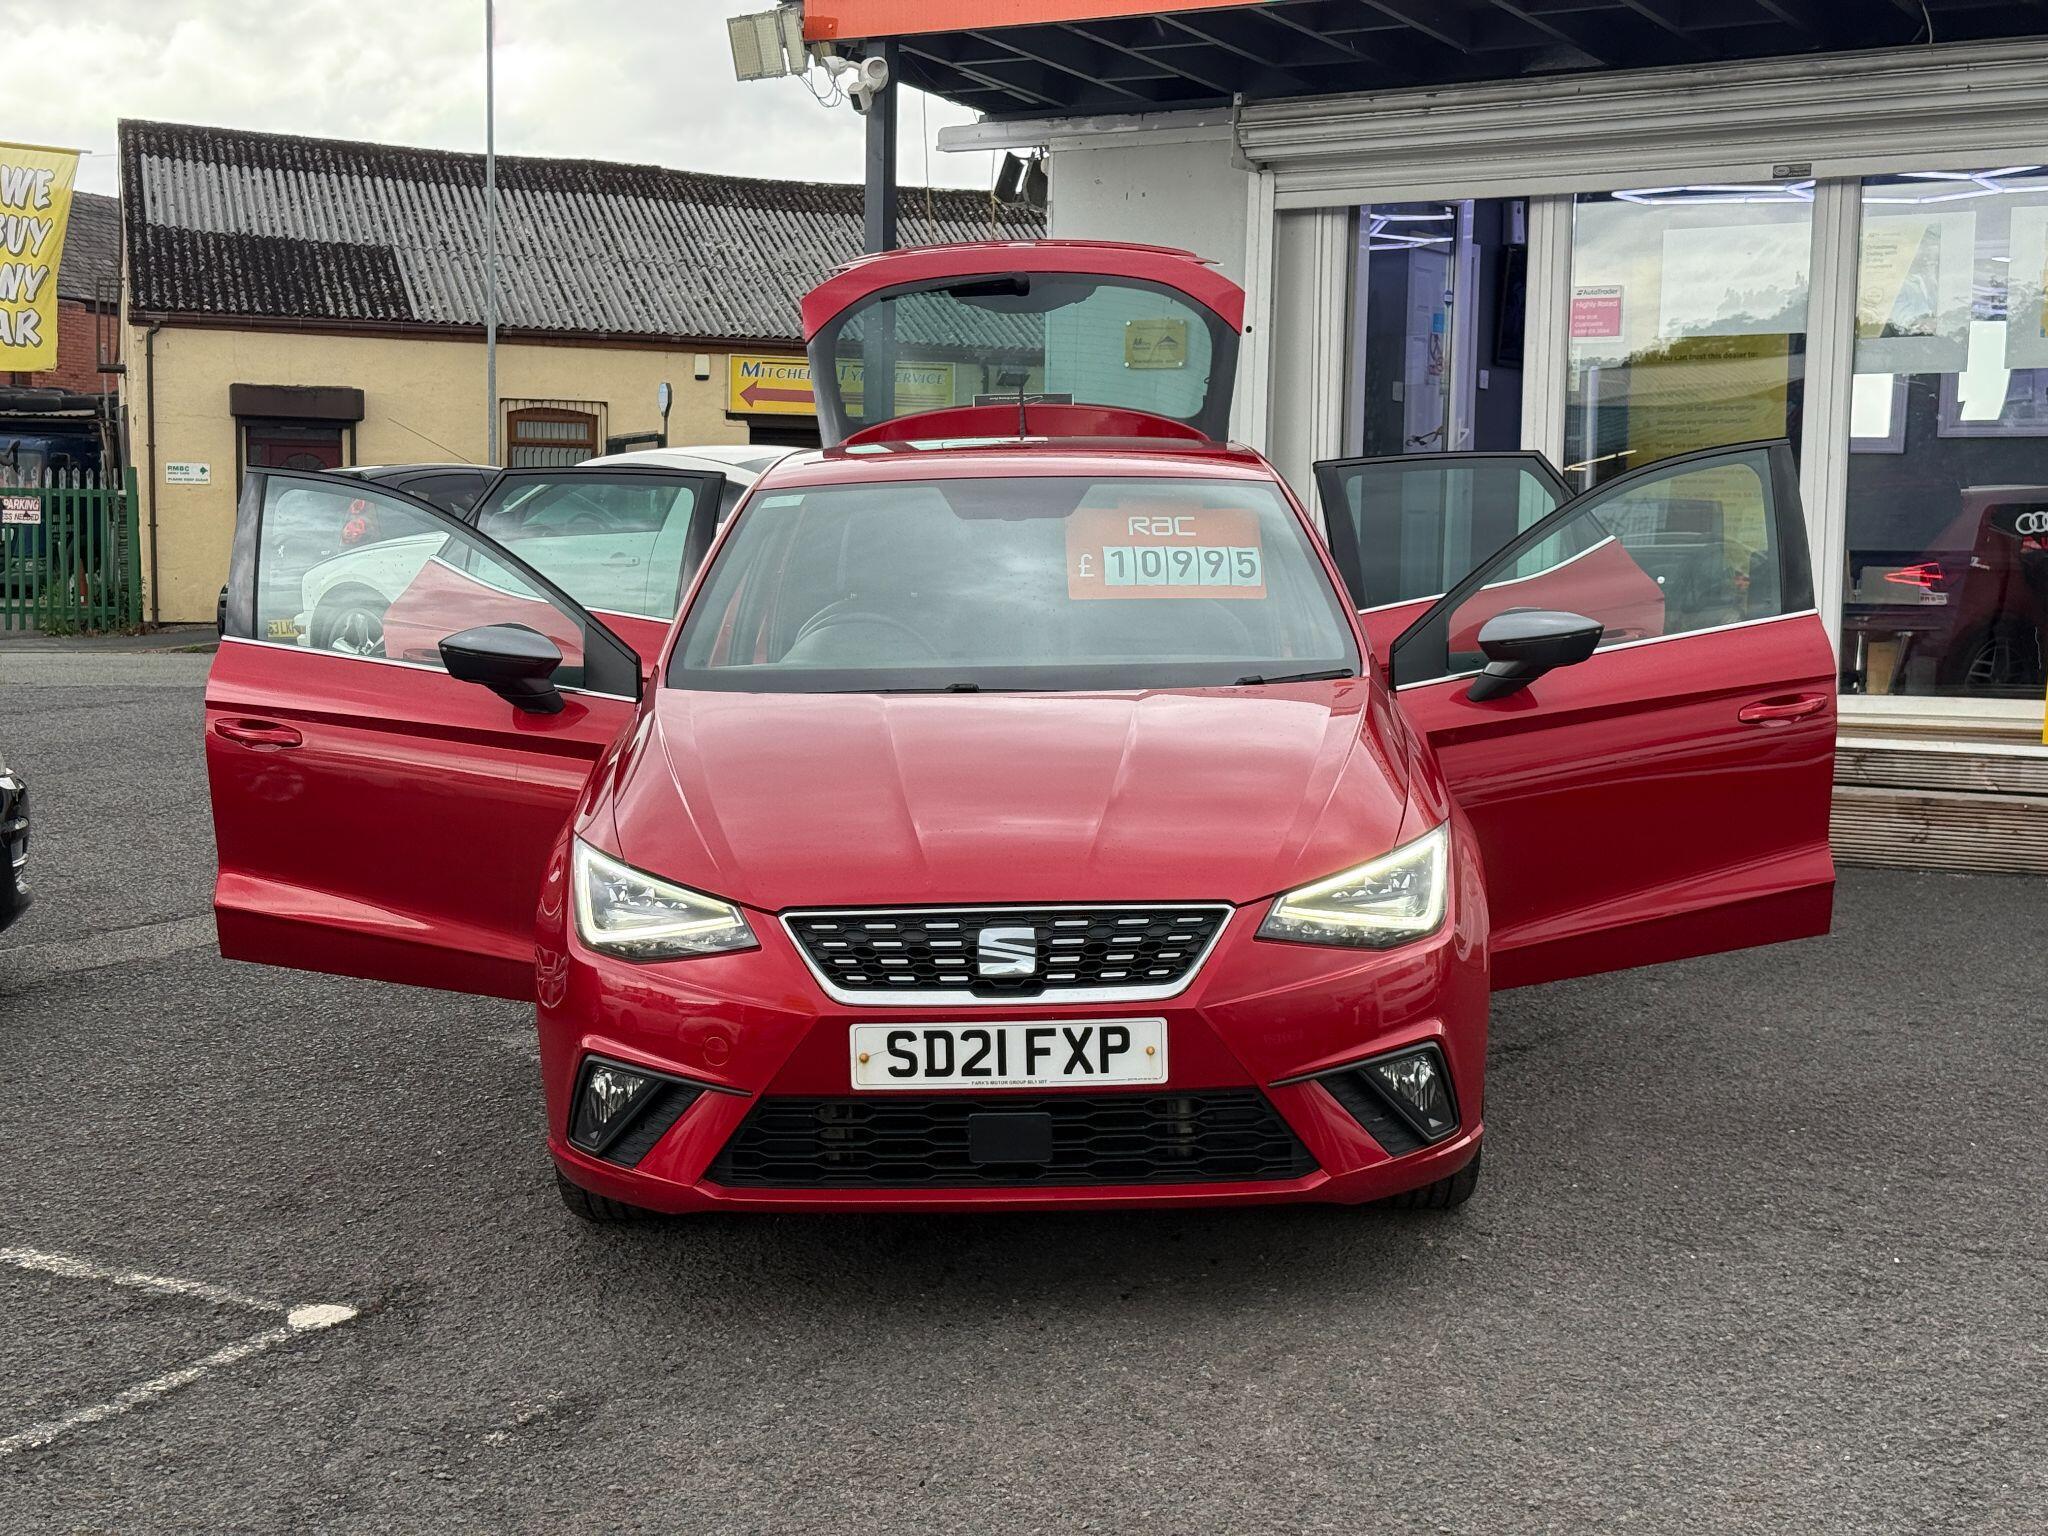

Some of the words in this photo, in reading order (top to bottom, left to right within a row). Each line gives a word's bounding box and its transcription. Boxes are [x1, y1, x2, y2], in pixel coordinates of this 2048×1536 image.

[0, 164, 54, 212] WE
[0, 262, 49, 302] NY
[0, 308, 42, 347] AR
[741, 361, 812, 380] MITCHEL
[895, 371, 944, 385] ERVICE
[2, 498, 39, 510] PARKING
[1078, 553, 1095, 578] £
[1110, 550, 1257, 579] 10995
[886, 1028, 1007, 1079] SD21
[1026, 1025, 1131, 1076] FXP
